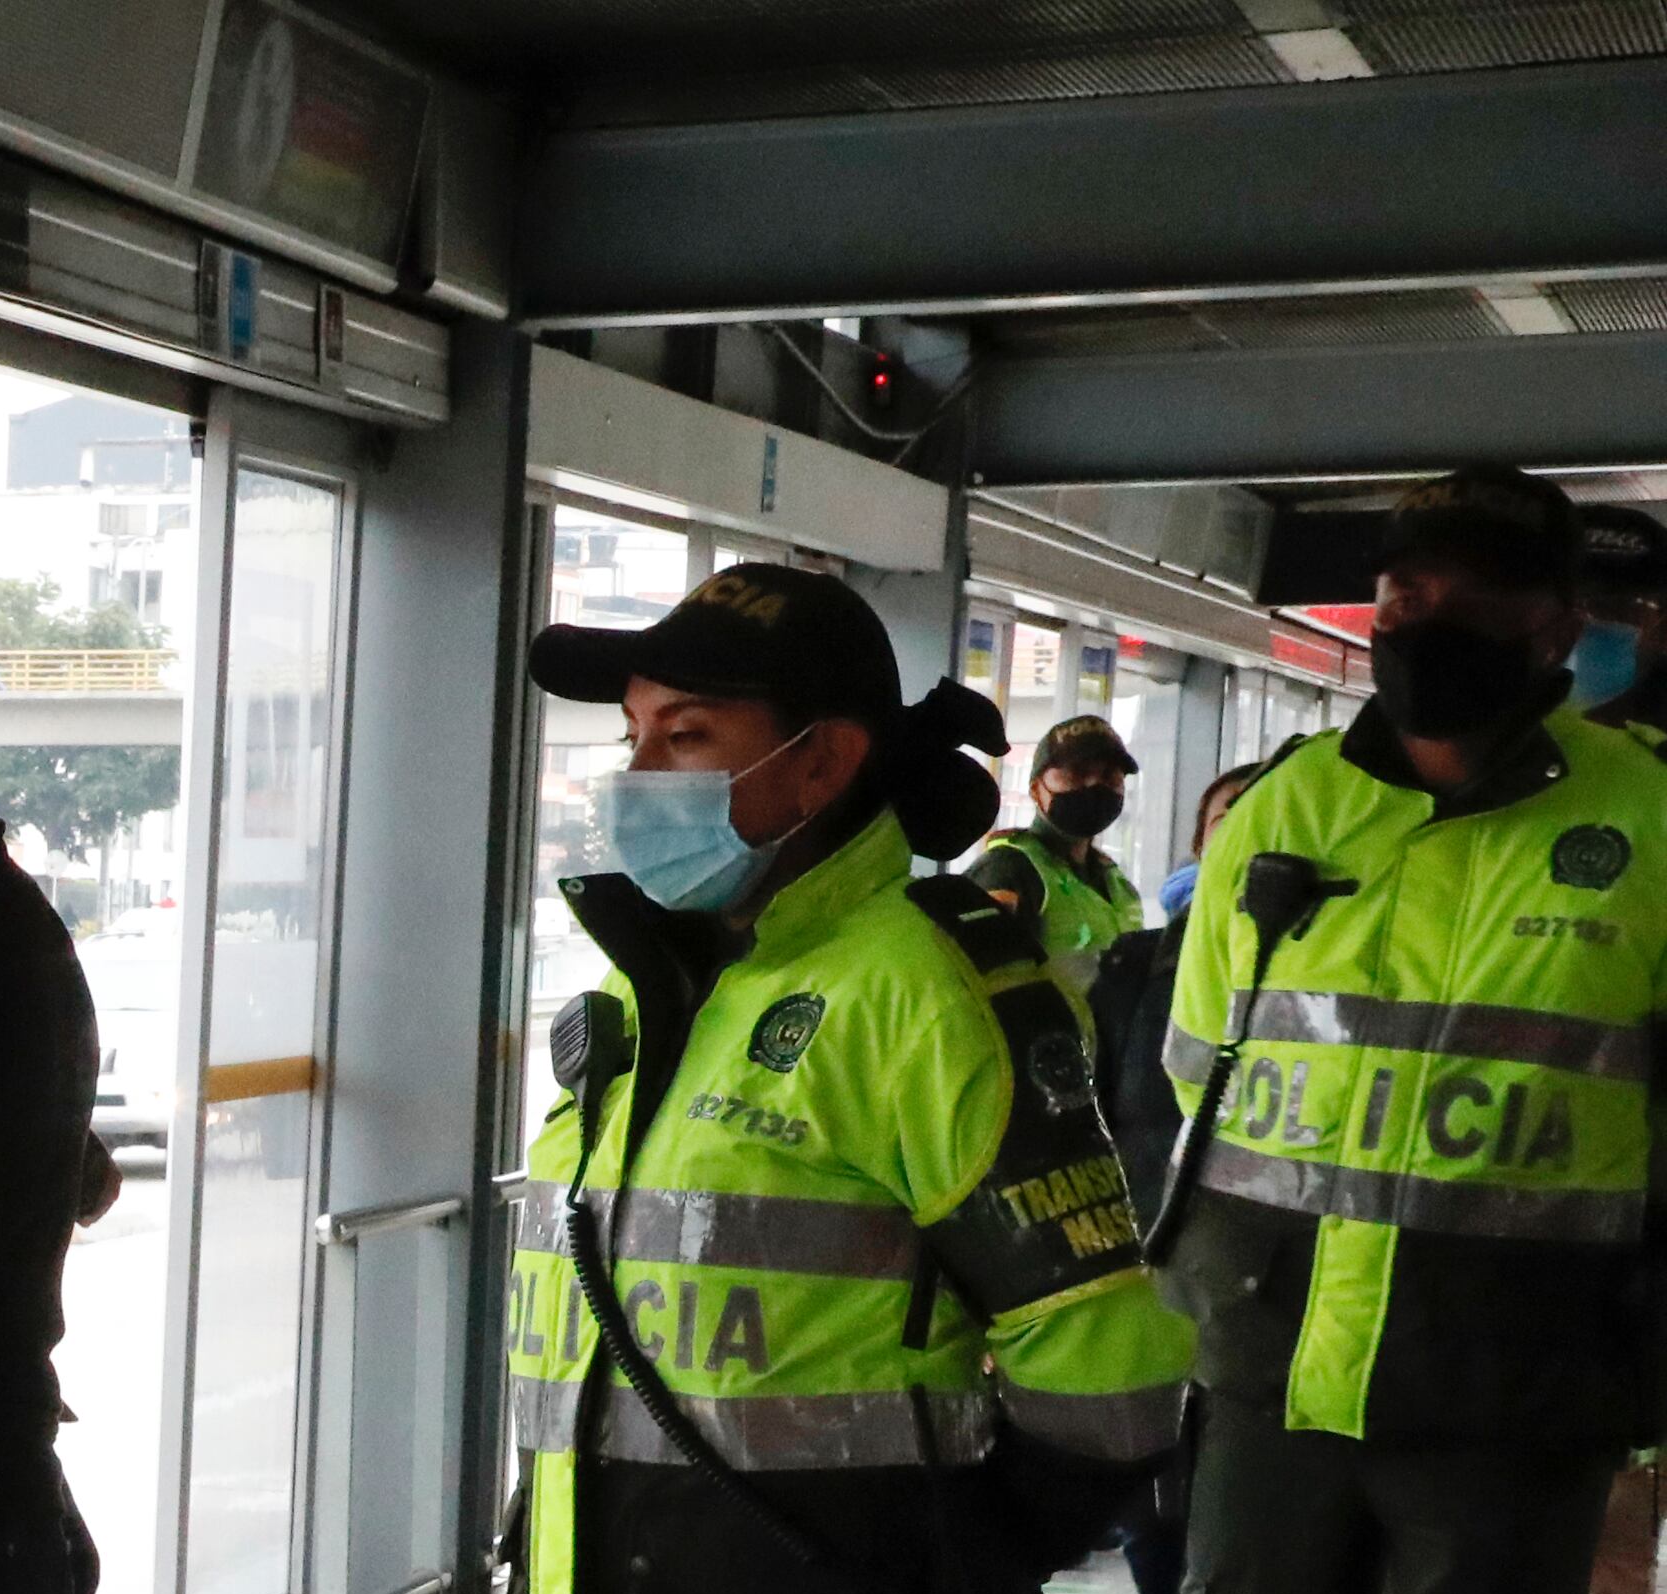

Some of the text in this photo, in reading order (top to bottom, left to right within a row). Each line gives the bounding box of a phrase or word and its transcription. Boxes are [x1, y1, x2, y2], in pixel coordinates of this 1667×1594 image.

[1000, 1155, 1124, 1228] TRANSP
[1061, 1202, 1135, 1259] MAS
[507, 1269, 768, 1375] OLICIA
